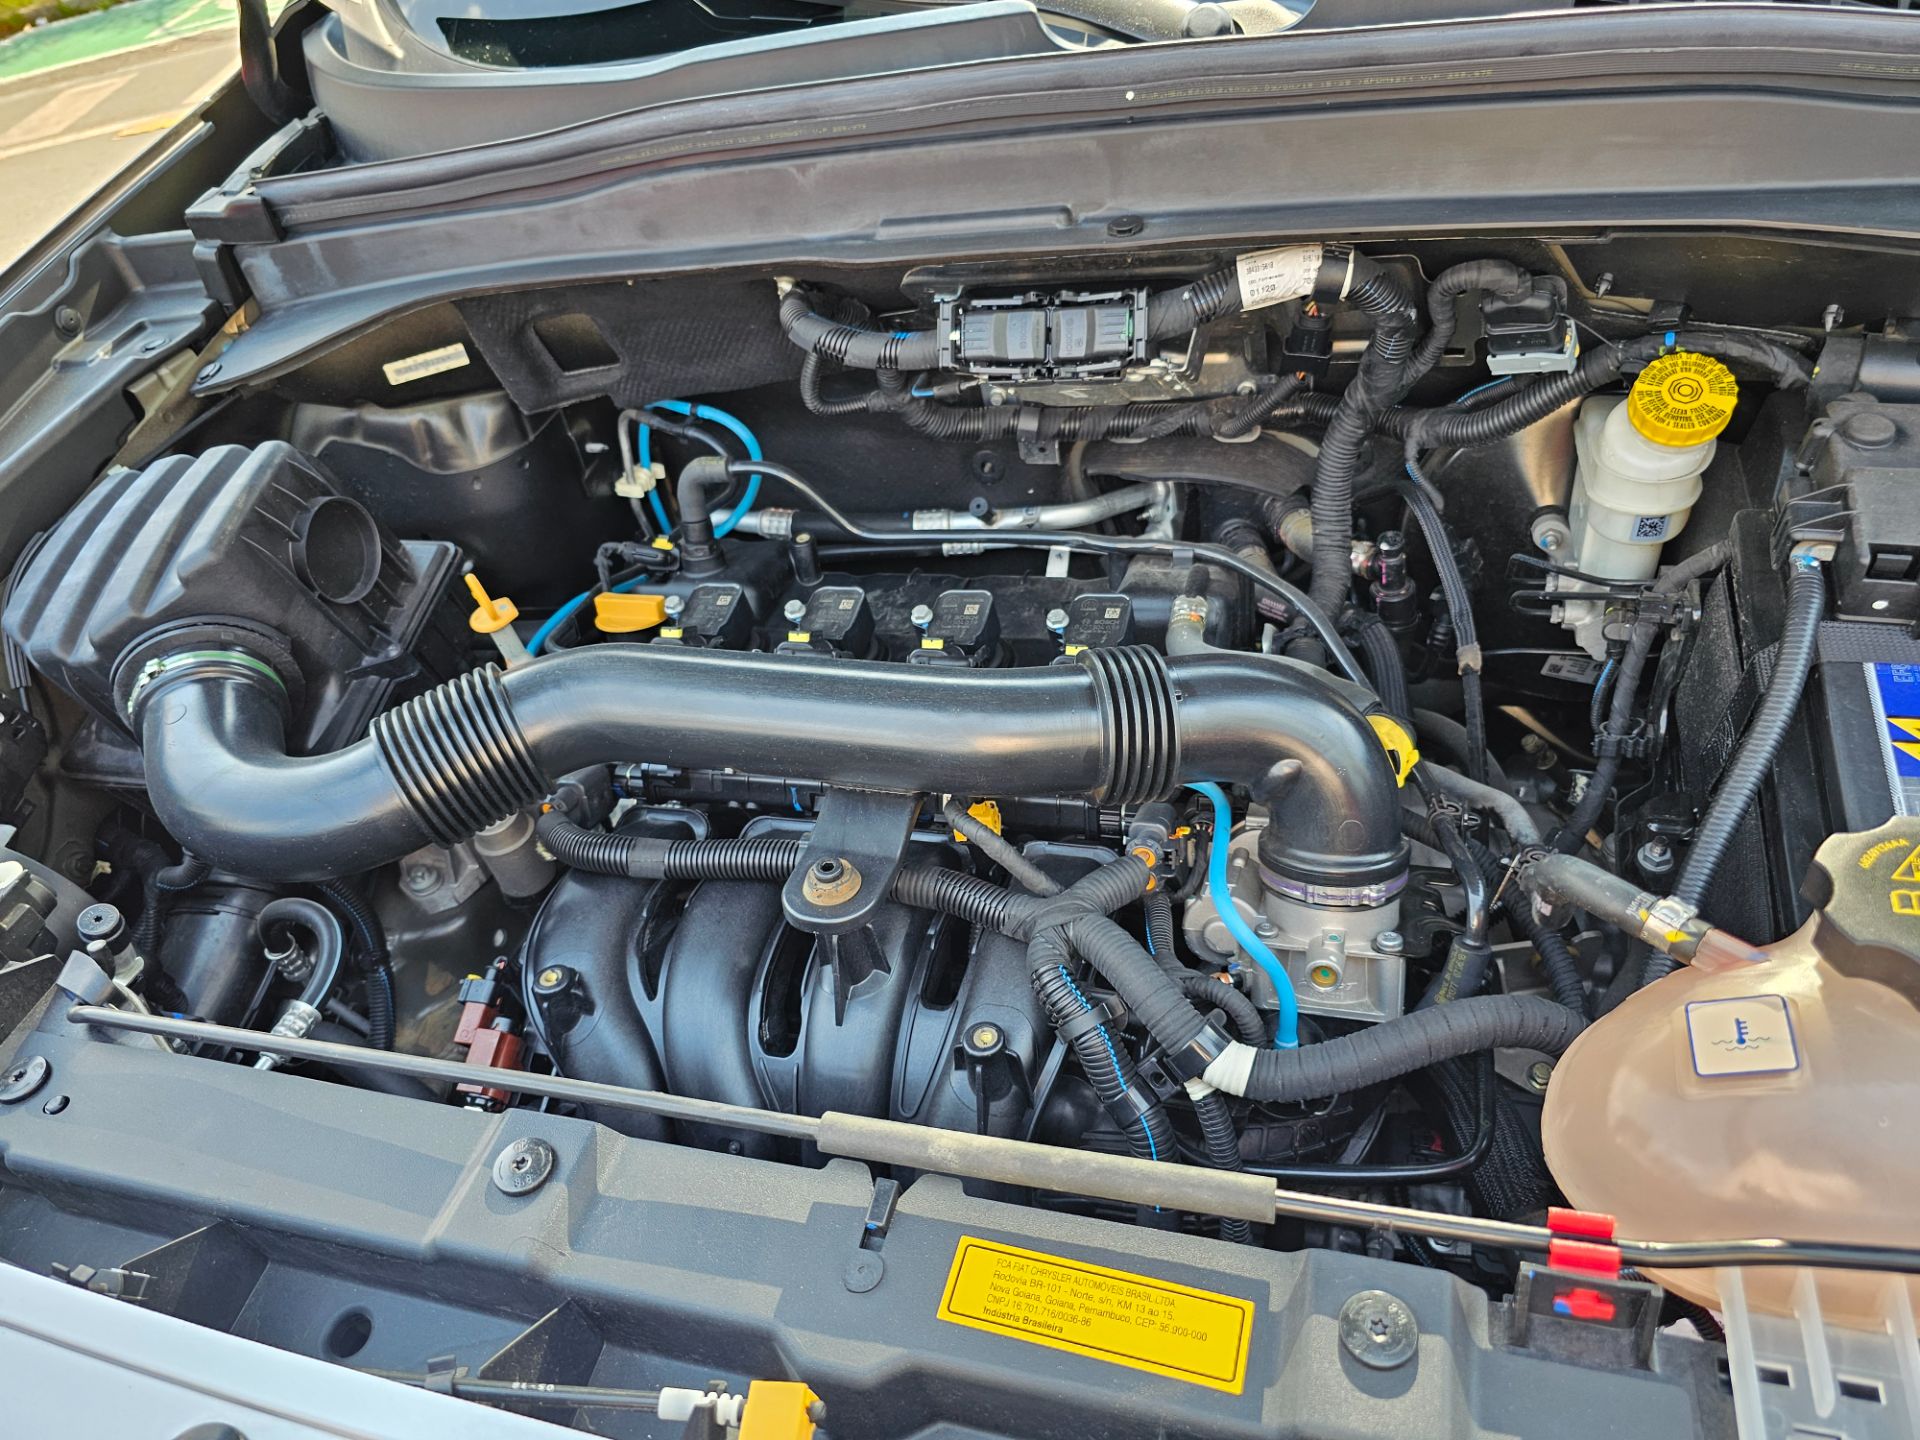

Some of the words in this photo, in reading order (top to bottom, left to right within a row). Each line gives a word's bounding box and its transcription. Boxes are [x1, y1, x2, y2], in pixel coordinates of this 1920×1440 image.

[986, 1293, 1011, 1308] CNPJ
[993, 1269, 1028, 1286] Rodovia
[1029, 1278, 1062, 1294] BR-101
[1117, 1299, 1133, 1311] KM
[1135, 1303, 1146, 1314] 13
[1147, 1307, 1160, 1317] ao
[996, 1258, 1012, 1269] FCA
[1013, 1262, 1029, 1273] FIAT
[1030, 1266, 1073, 1284] CHRYSLER
[1125, 1288, 1153, 1303] BRASIL
[989, 1281, 1011, 1295] Nova
[1078, 1302, 1133, 1325] Pernambuco,
[1021, 1315, 1064, 1334] Brasileira
